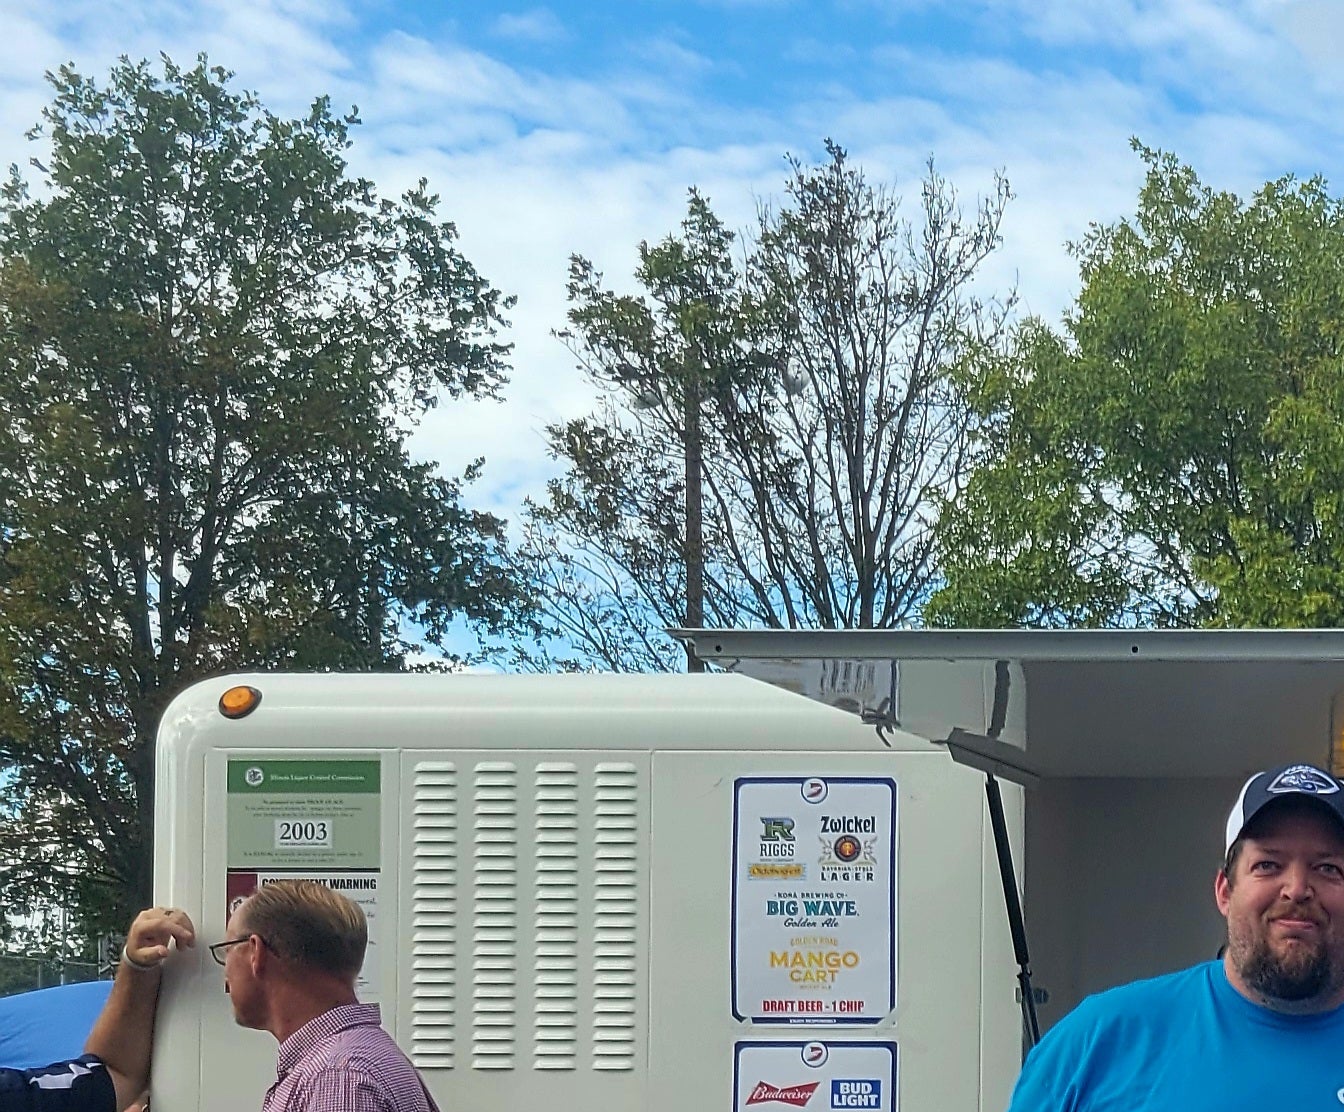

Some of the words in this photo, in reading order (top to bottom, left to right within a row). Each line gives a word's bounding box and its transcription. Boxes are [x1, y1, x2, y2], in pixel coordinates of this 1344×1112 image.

[820, 816, 876, 833] Zwickel
[280, 823, 327, 840] 2003
[760, 843, 795, 856] RIGGS
[330, 879, 377, 889] WARNING
[767, 901, 798, 916] BIG
[784, 918, 816, 927] Golden
[821, 918, 839, 927] Ale
[770, 951, 859, 968] MANGO
[789, 970, 839, 982] CART
[763, 1000, 795, 1012] DRAFT
[798, 1000, 822, 1012] BEER
[832, 1001, 836, 1012] 1
[839, 1000, 864, 1012] CHIP
[752, 1086, 813, 1100] Budweiser
[840, 1082, 872, 1094] BUD
[834, 1095, 878, 1106] LIGHT
